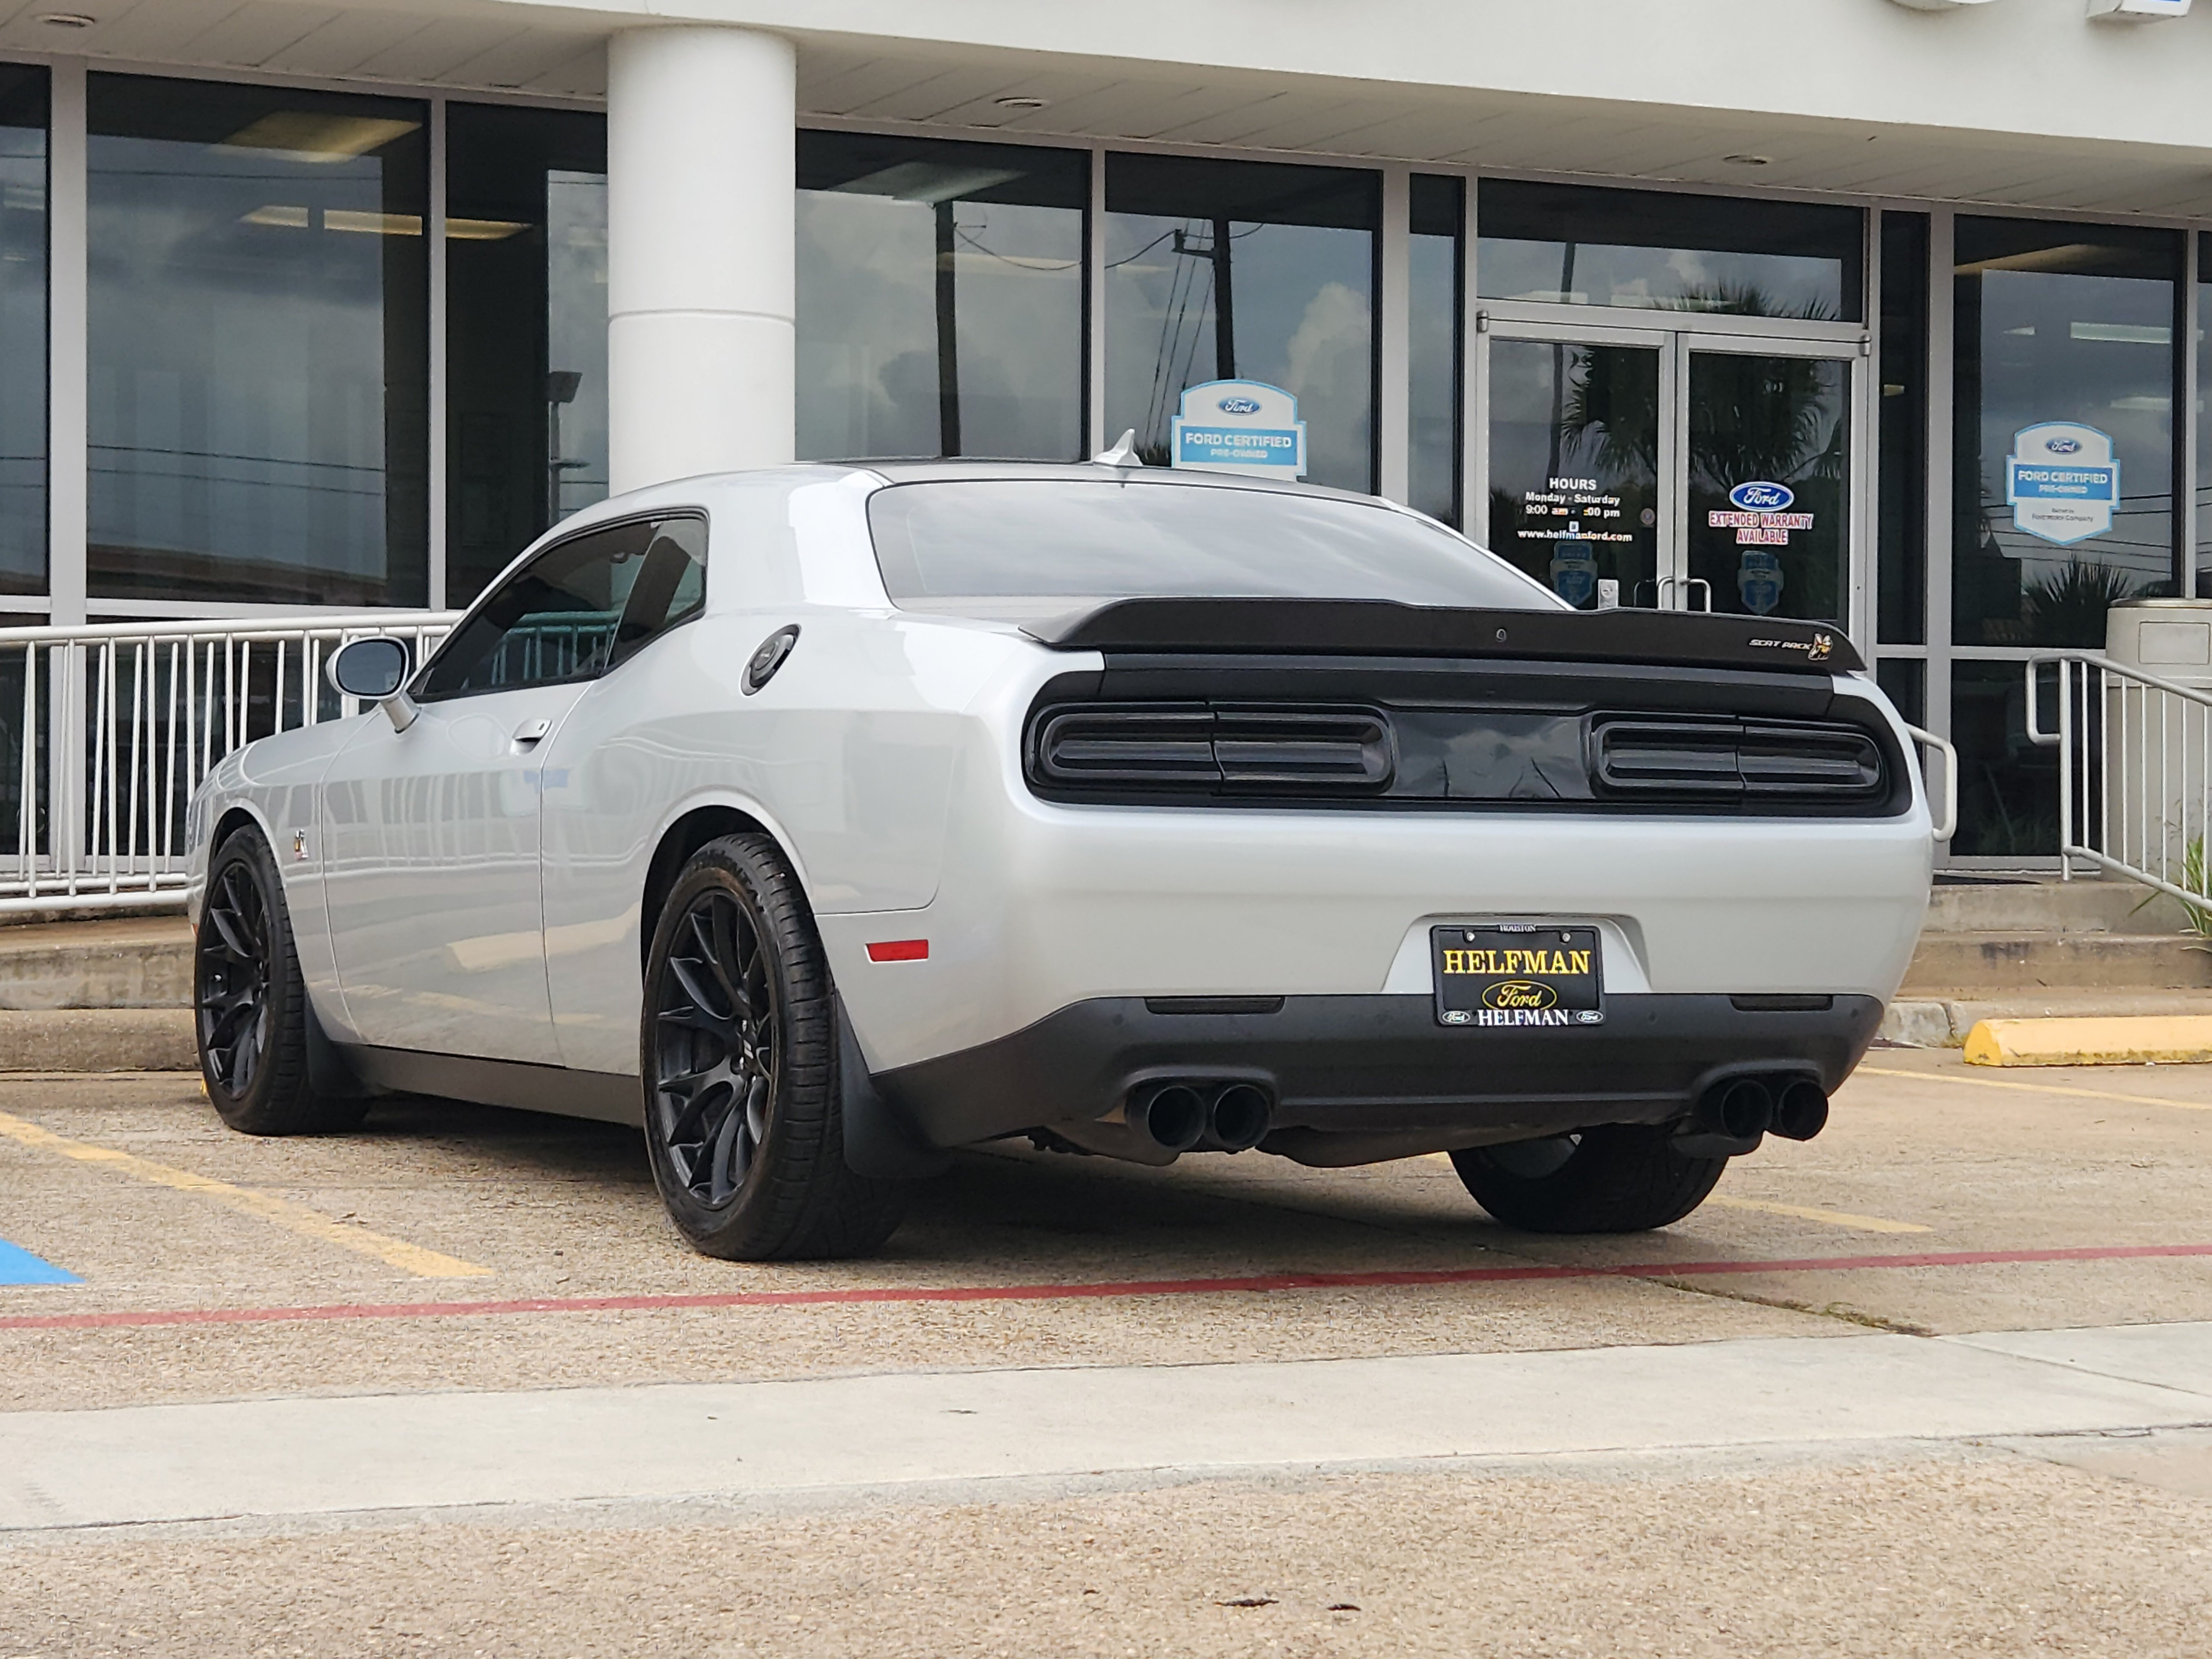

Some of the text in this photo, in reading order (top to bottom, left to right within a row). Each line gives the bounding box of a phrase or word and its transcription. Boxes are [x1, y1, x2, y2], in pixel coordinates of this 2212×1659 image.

[1225, 399, 1253, 412] Ford
[1185, 432, 1292, 447] FORD CERTIFIED
[1549, 477, 1597, 490] HOURS
[2018, 470, 2108, 483] FORD CERTIFIED
[1525, 492, 1566, 504] Monday
[1573, 493, 1621, 507] Saturday
[1743, 487, 1781, 505] Ford
[1525, 504, 1548, 515] 9:00
[1603, 509, 1620, 519] pm
[1710, 513, 1813, 528] EXTENDED WARRANTY
[1517, 529, 1633, 541] www.helfmanford.com
[1737, 529, 1788, 543] AVAILABLE
[1782, 642, 1813, 650] PACK
[1443, 950, 1591, 974] HELFMAN
[1497, 984, 1542, 1007] Ford
[1477, 1009, 1569, 1026] HELFMAN
